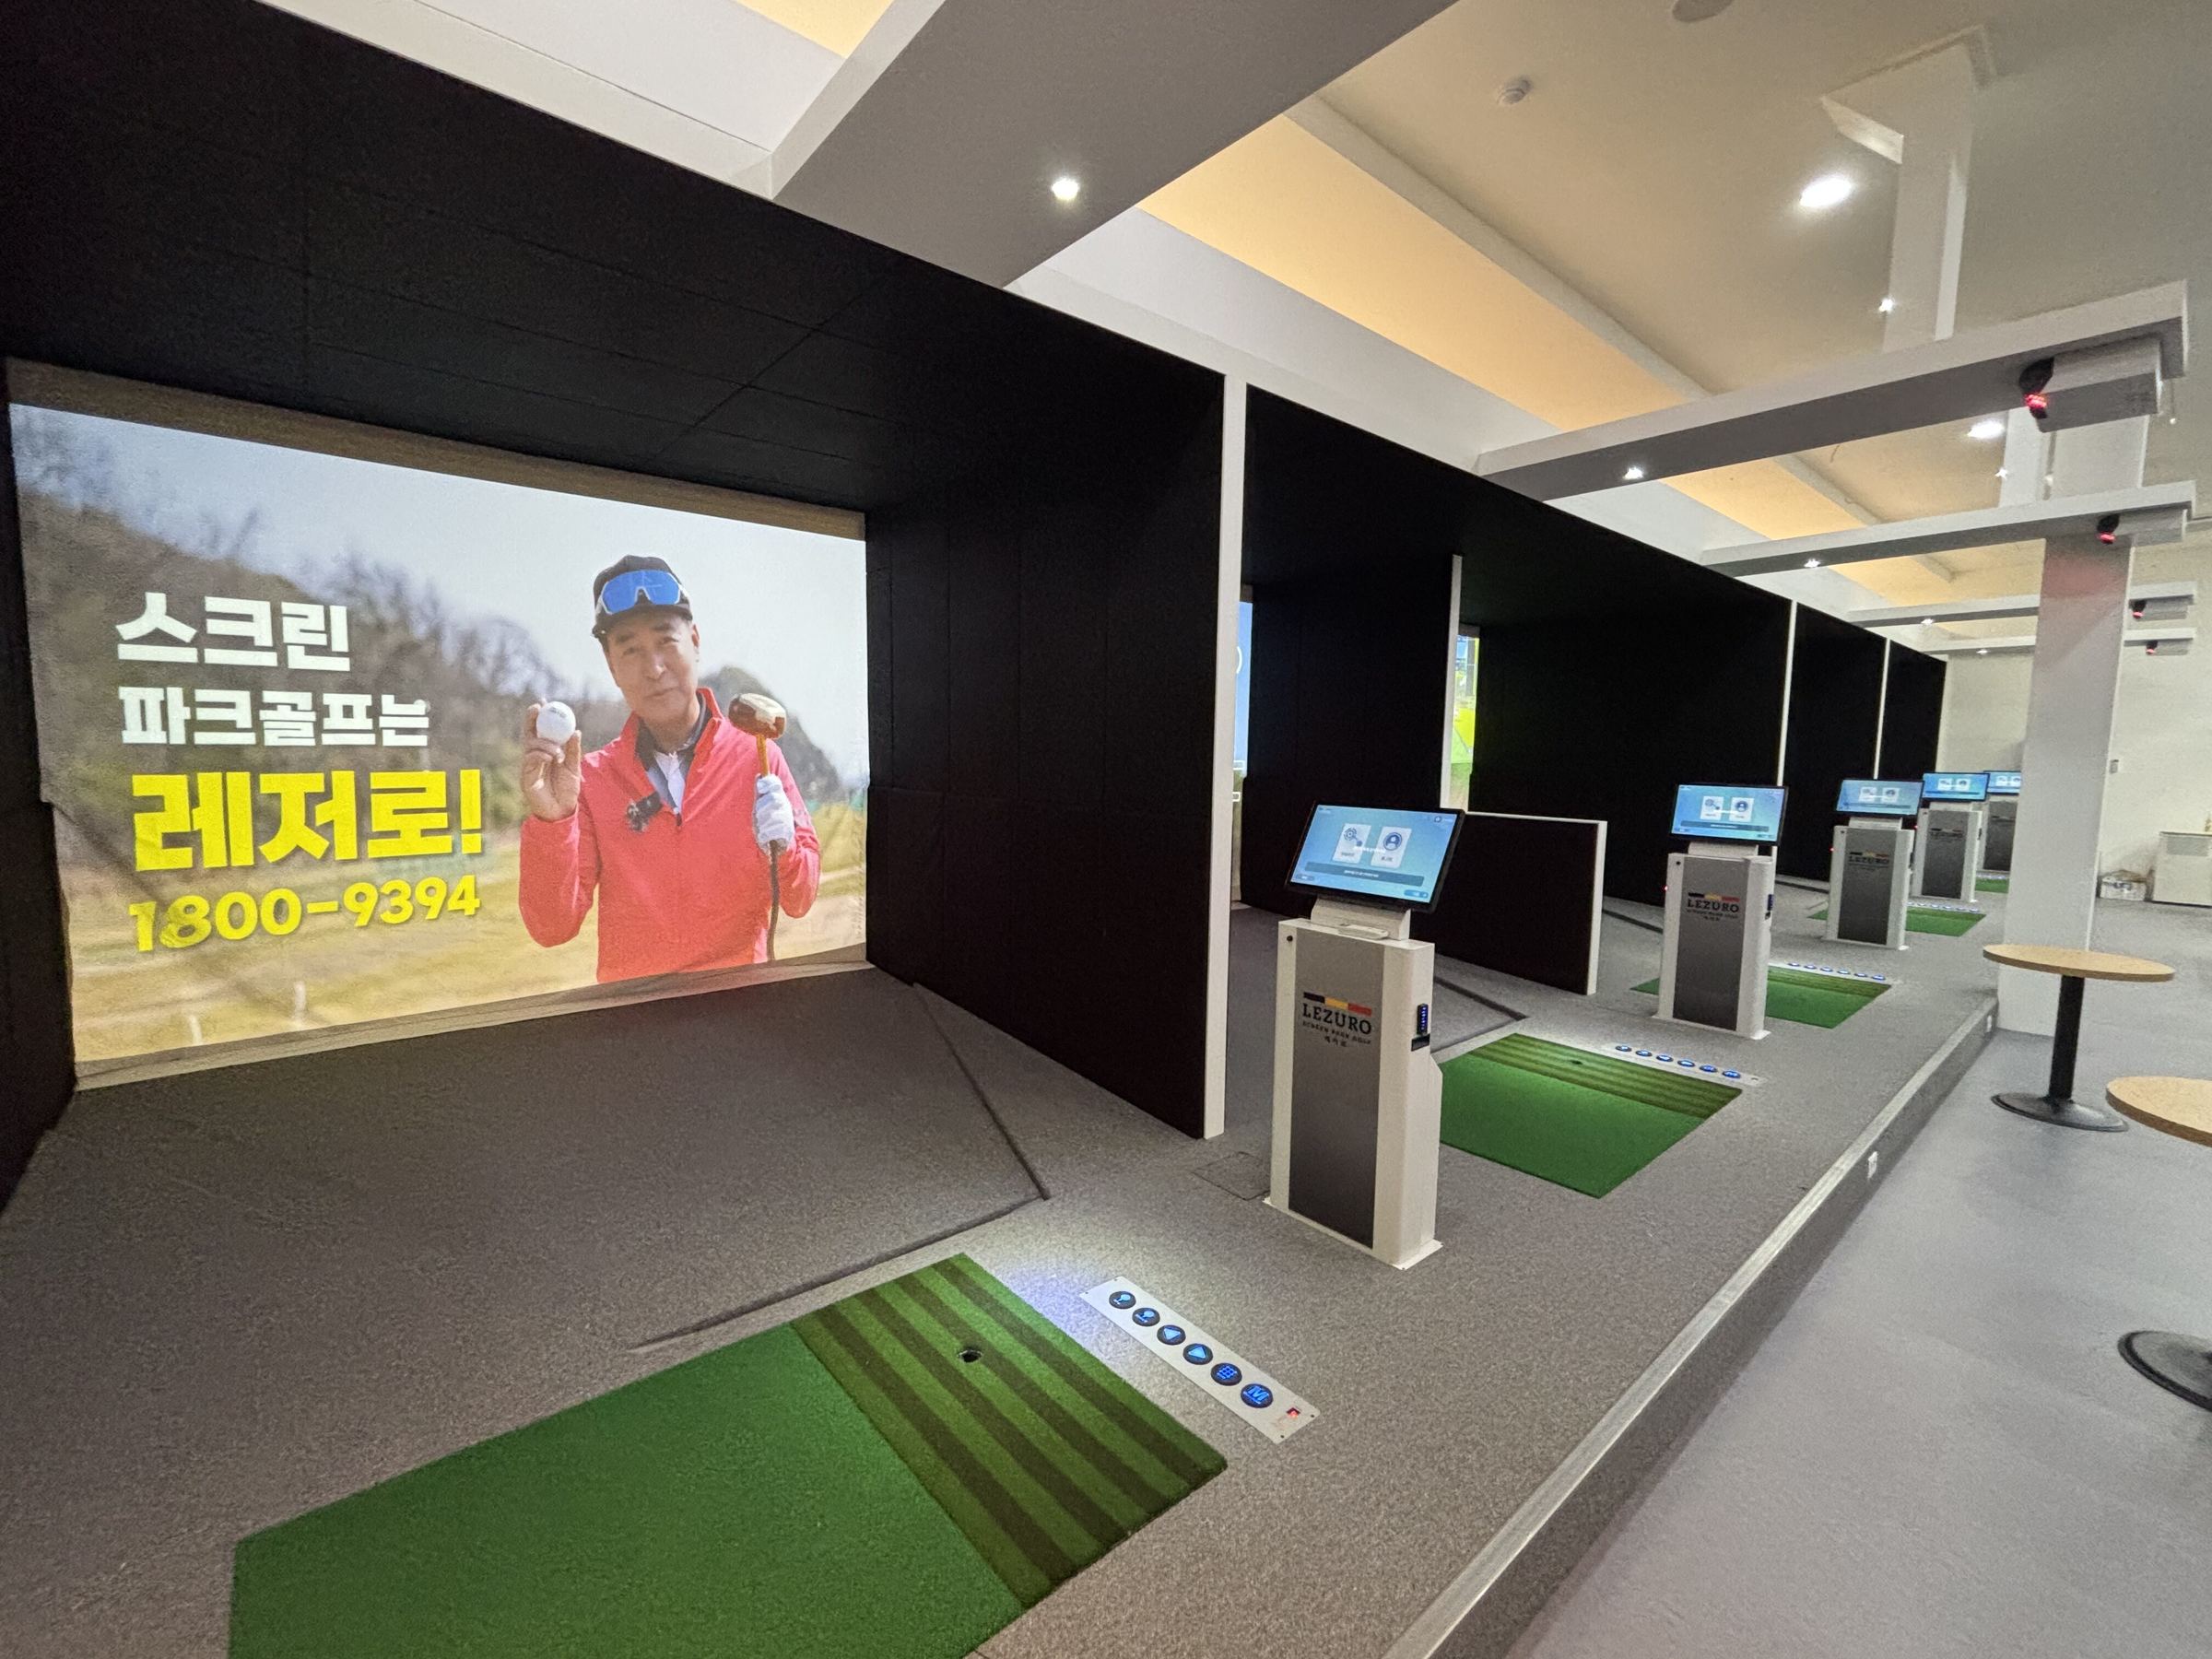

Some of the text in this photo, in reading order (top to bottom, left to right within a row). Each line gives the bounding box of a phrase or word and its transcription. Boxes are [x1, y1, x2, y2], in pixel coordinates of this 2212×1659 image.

[115, 592, 350, 671] 스크린
[118, 686, 430, 747] 파크골프는
[132, 769, 482, 871] 레저로!
[128, 875, 481, 952] 1800-9394
[1687, 899, 1740, 912] LEZURO
[1302, 1003, 1371, 1034] LEZURO
